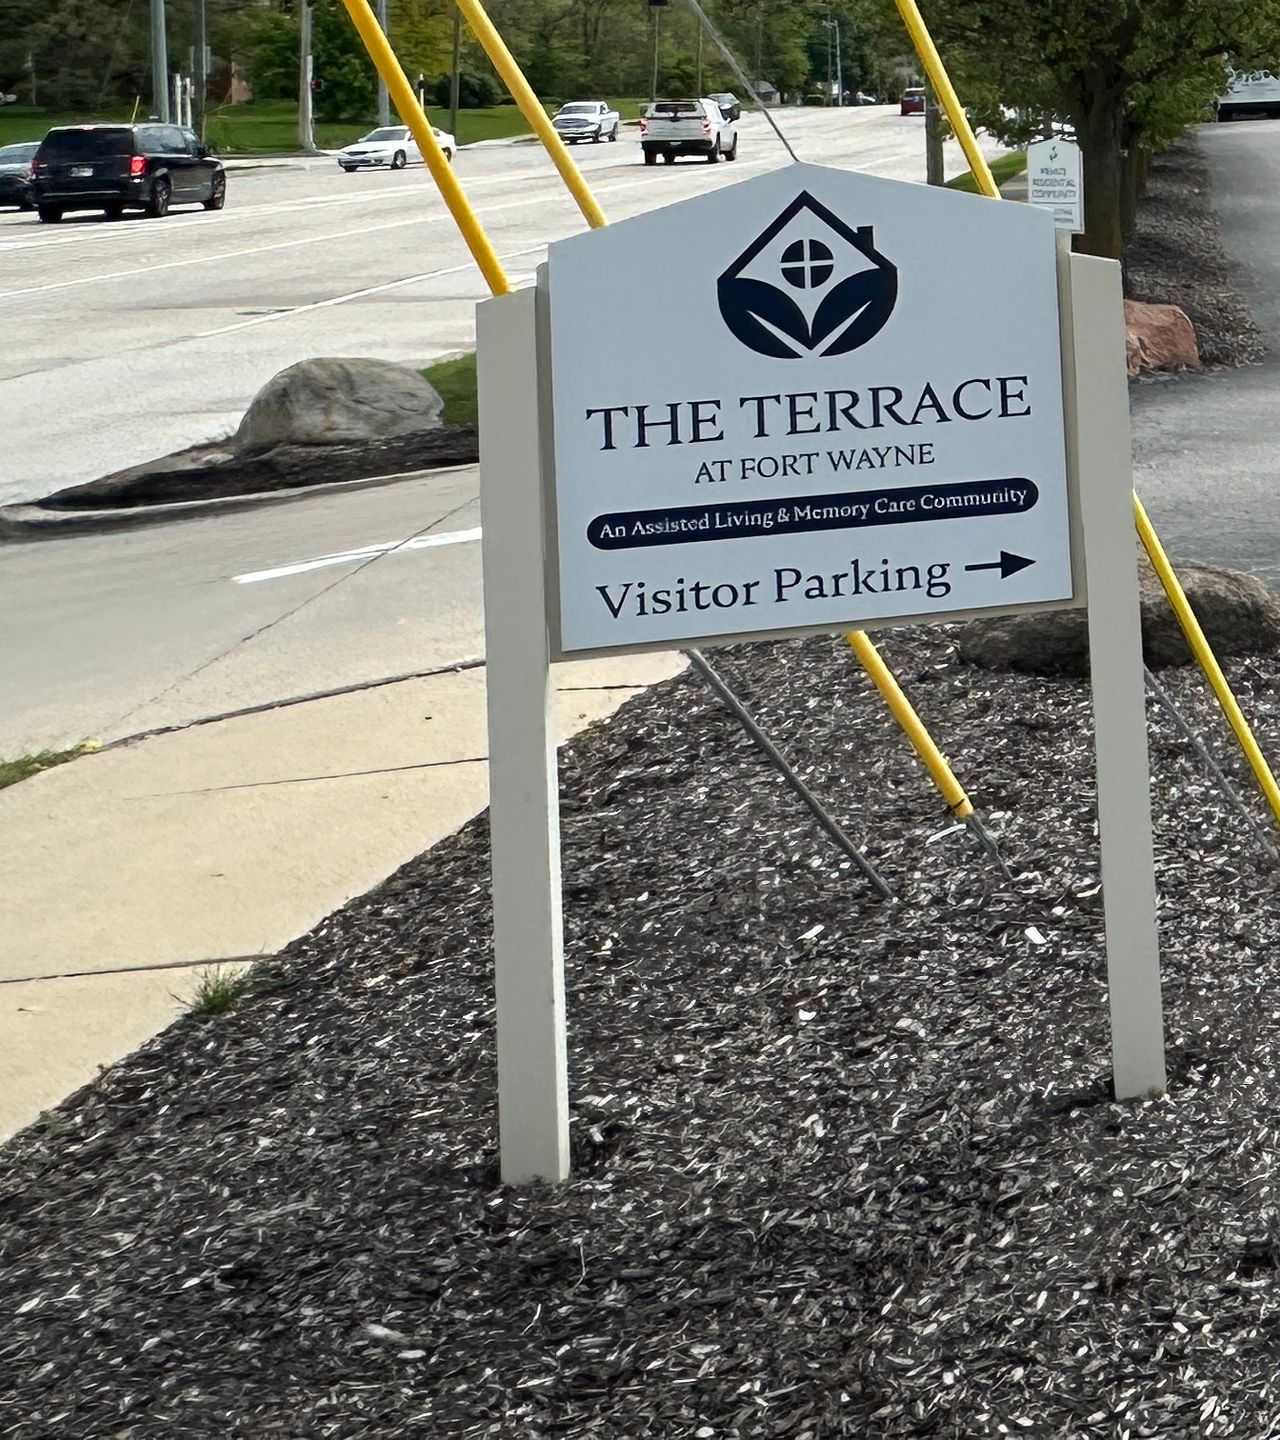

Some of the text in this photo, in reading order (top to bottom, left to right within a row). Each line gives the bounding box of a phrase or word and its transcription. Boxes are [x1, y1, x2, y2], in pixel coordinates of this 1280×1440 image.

[586, 376, 1031, 450] THE TERRACE
[695, 443, 935, 484] AT FORT WAYNE
[599, 487, 1029, 540] An Assisted Living & Memory Care Community
[596, 559, 952, 620] Visitor Parking
